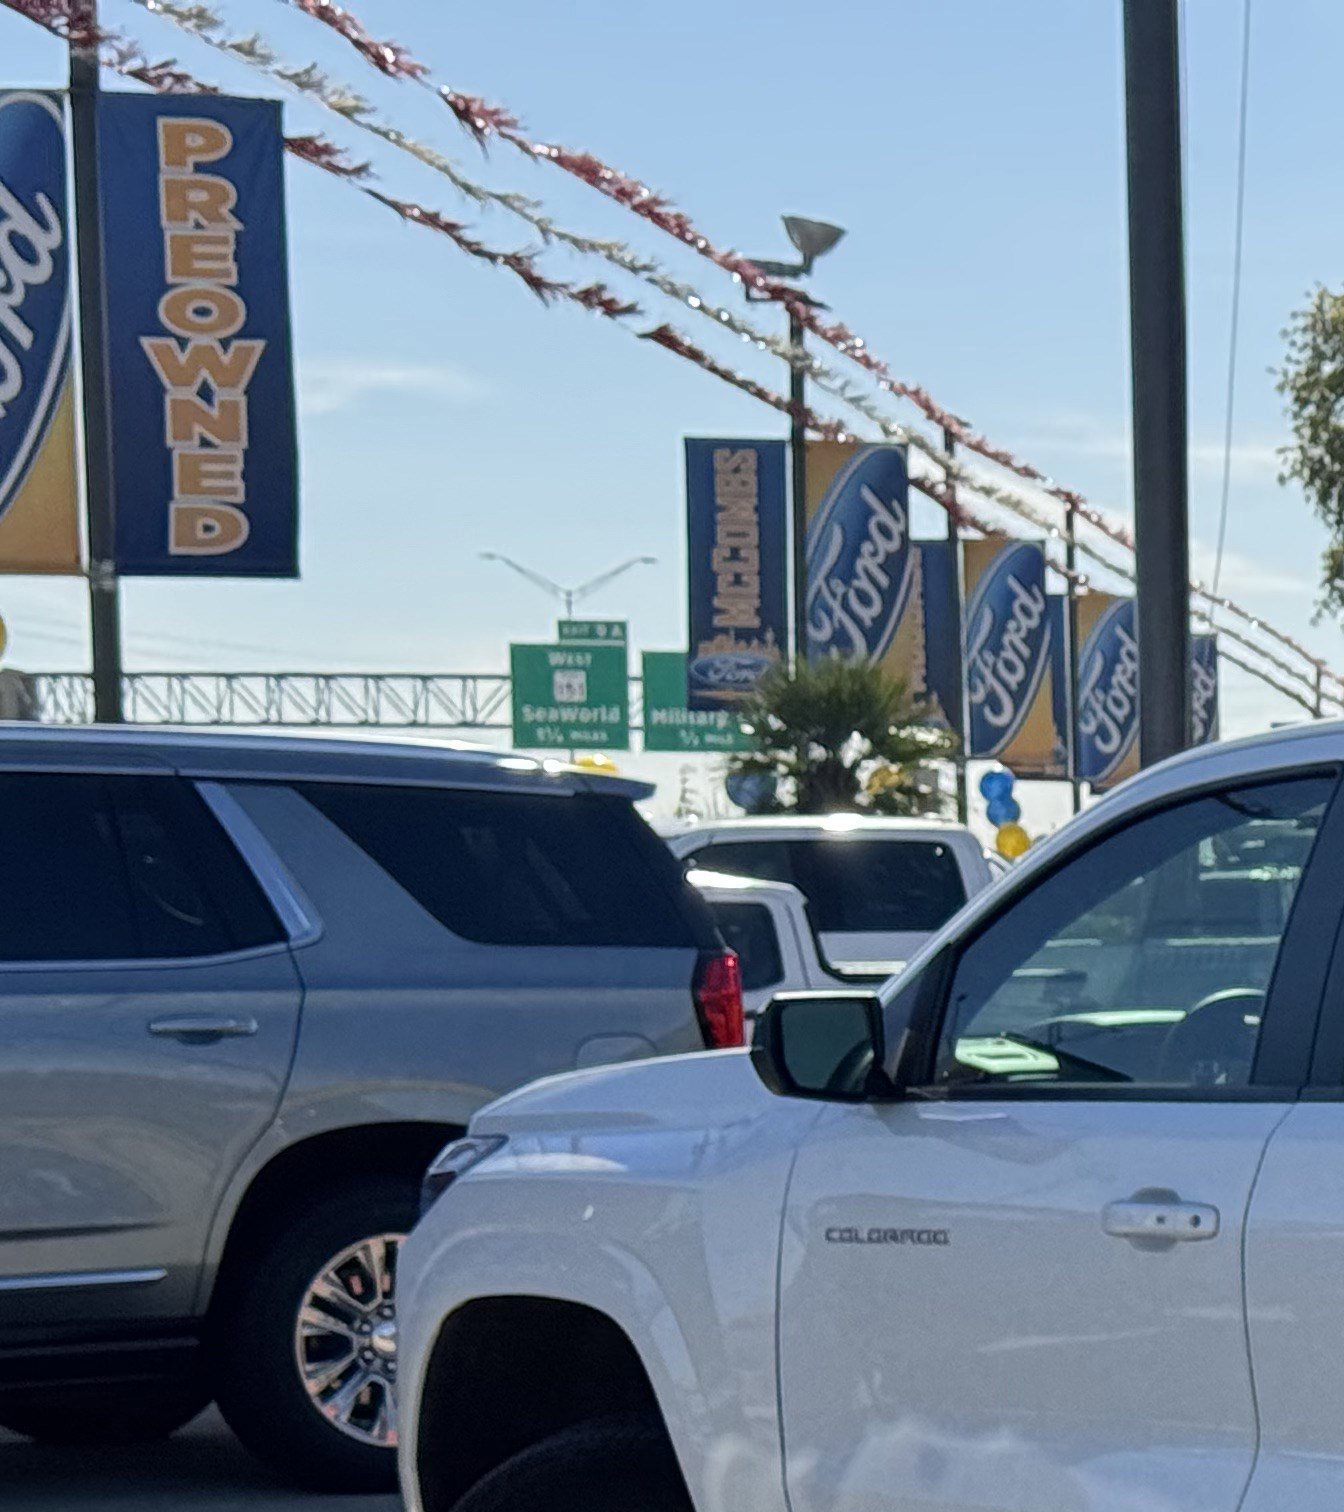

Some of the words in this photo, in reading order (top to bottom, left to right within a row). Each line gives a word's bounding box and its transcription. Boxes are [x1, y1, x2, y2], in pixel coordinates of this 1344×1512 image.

[968, 574, 1045, 727] Ford
[522, 704, 621, 724] SeaWorld
[651, 708, 729, 729] Military
[824, 1226, 950, 1246] COLORADO
